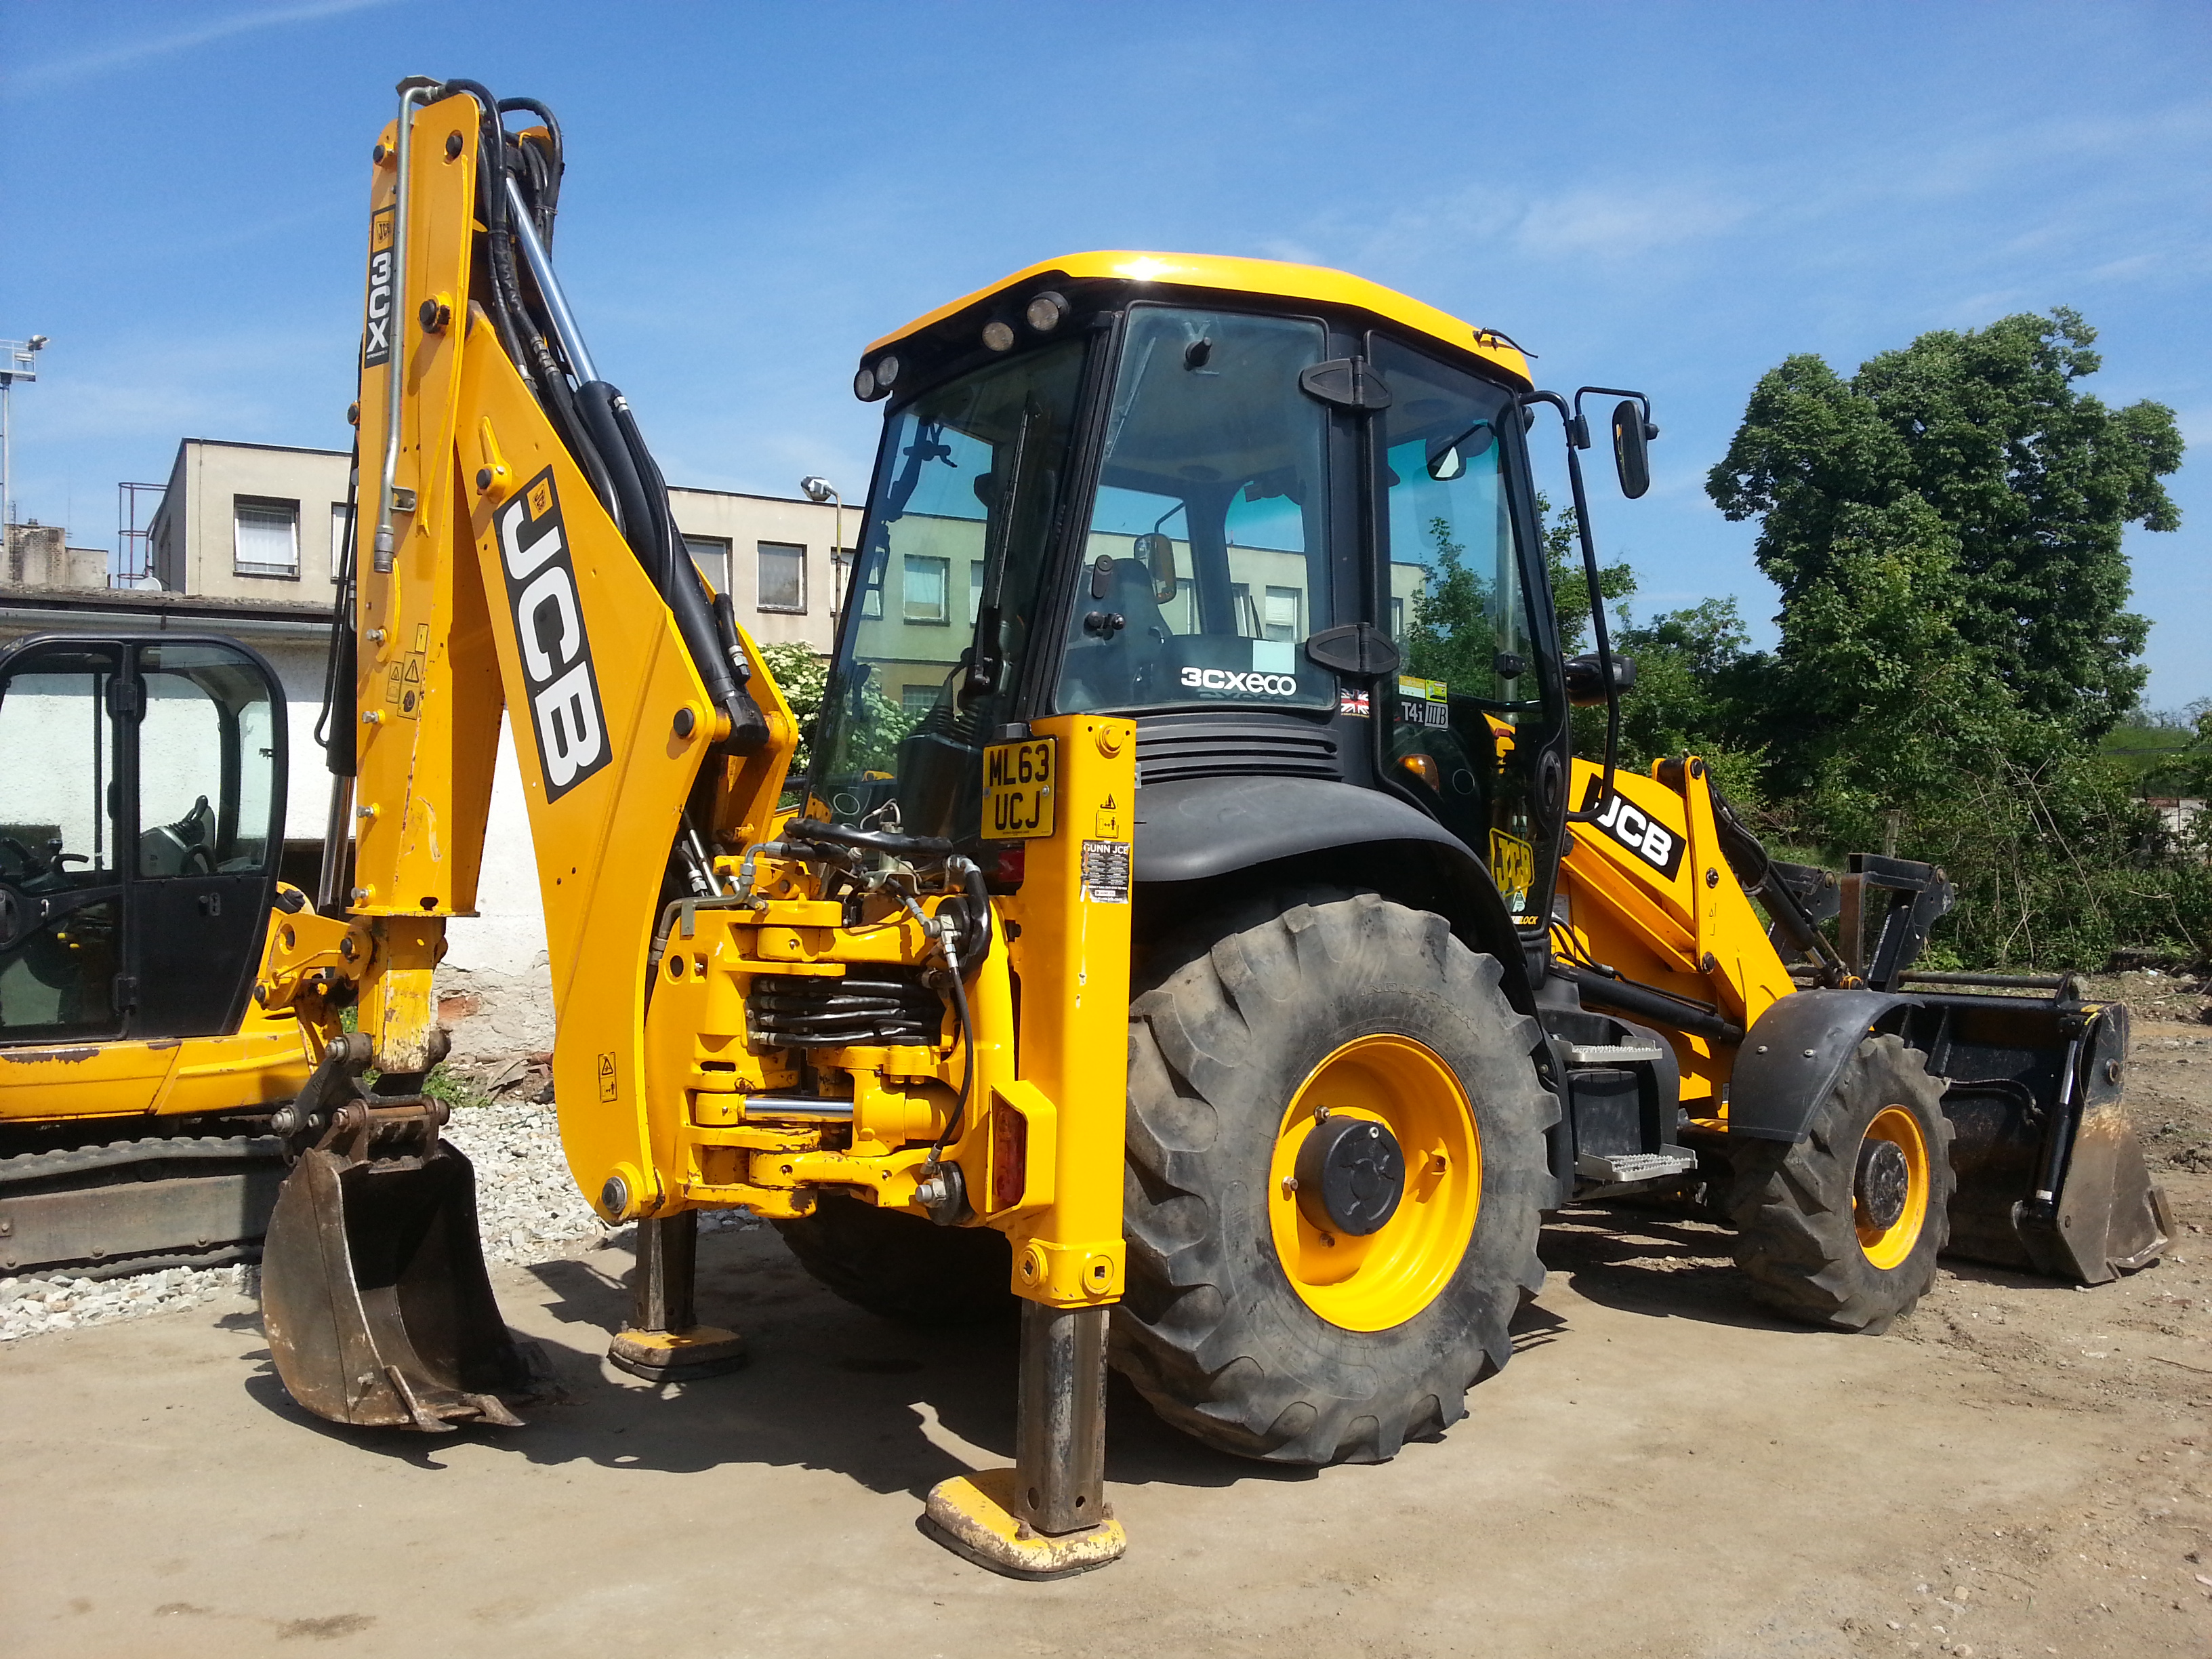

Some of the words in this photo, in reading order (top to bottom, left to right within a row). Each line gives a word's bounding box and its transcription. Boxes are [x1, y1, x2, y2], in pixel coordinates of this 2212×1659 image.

[366, 251, 392, 353] 3CX
[501, 499, 601, 787] JCB
[1401, 701, 1424, 722] T4i
[989, 743, 1050, 787] ML63
[994, 790, 1041, 831] UCJ
[1594, 795, 1673, 866] JCB
[1083, 843, 1111, 853] GUNN
[1496, 836, 1532, 892] JCB
